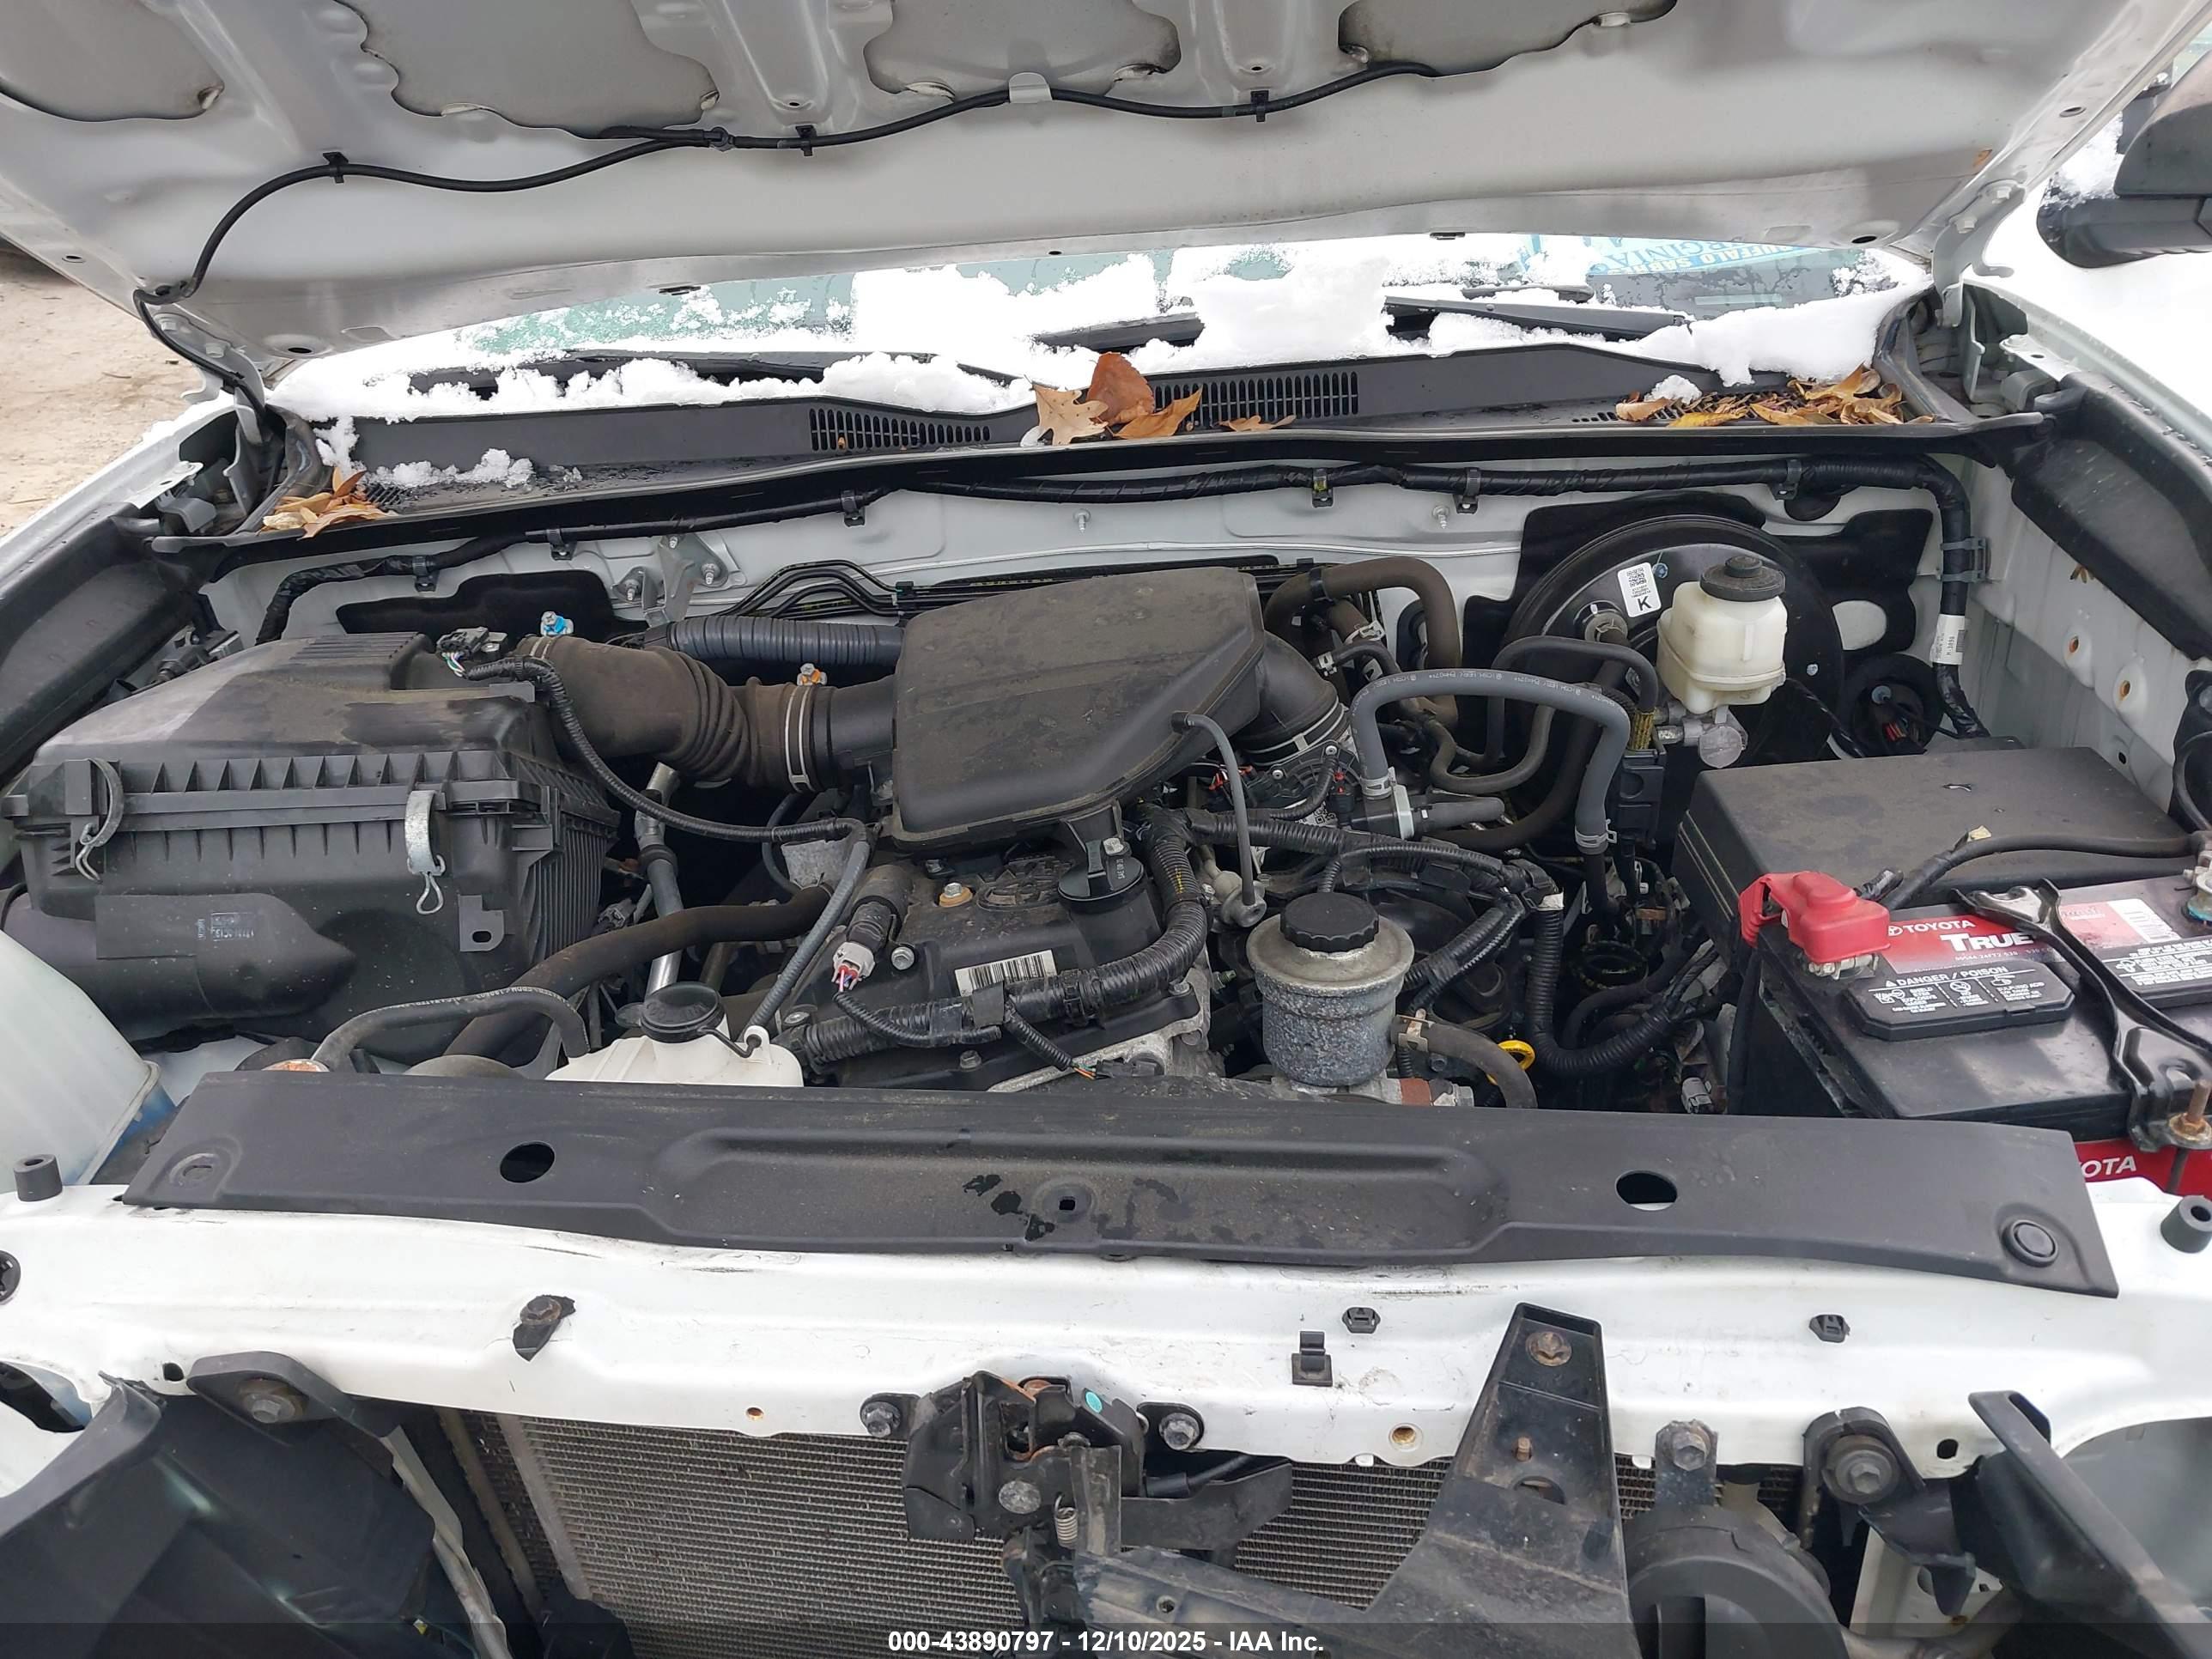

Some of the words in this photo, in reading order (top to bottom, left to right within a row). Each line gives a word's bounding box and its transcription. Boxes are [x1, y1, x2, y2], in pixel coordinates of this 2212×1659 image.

[1638, 595, 1652, 611] K
[1904, 920, 1976, 933] TOYOTA
[1940, 932, 2034, 952] TRUE
[1898, 974, 1949, 987] DANGER
[1950, 972, 1958, 981] /
[1959, 966, 2009, 978] POISON
[2080, 1155, 2137, 1178] OTA
